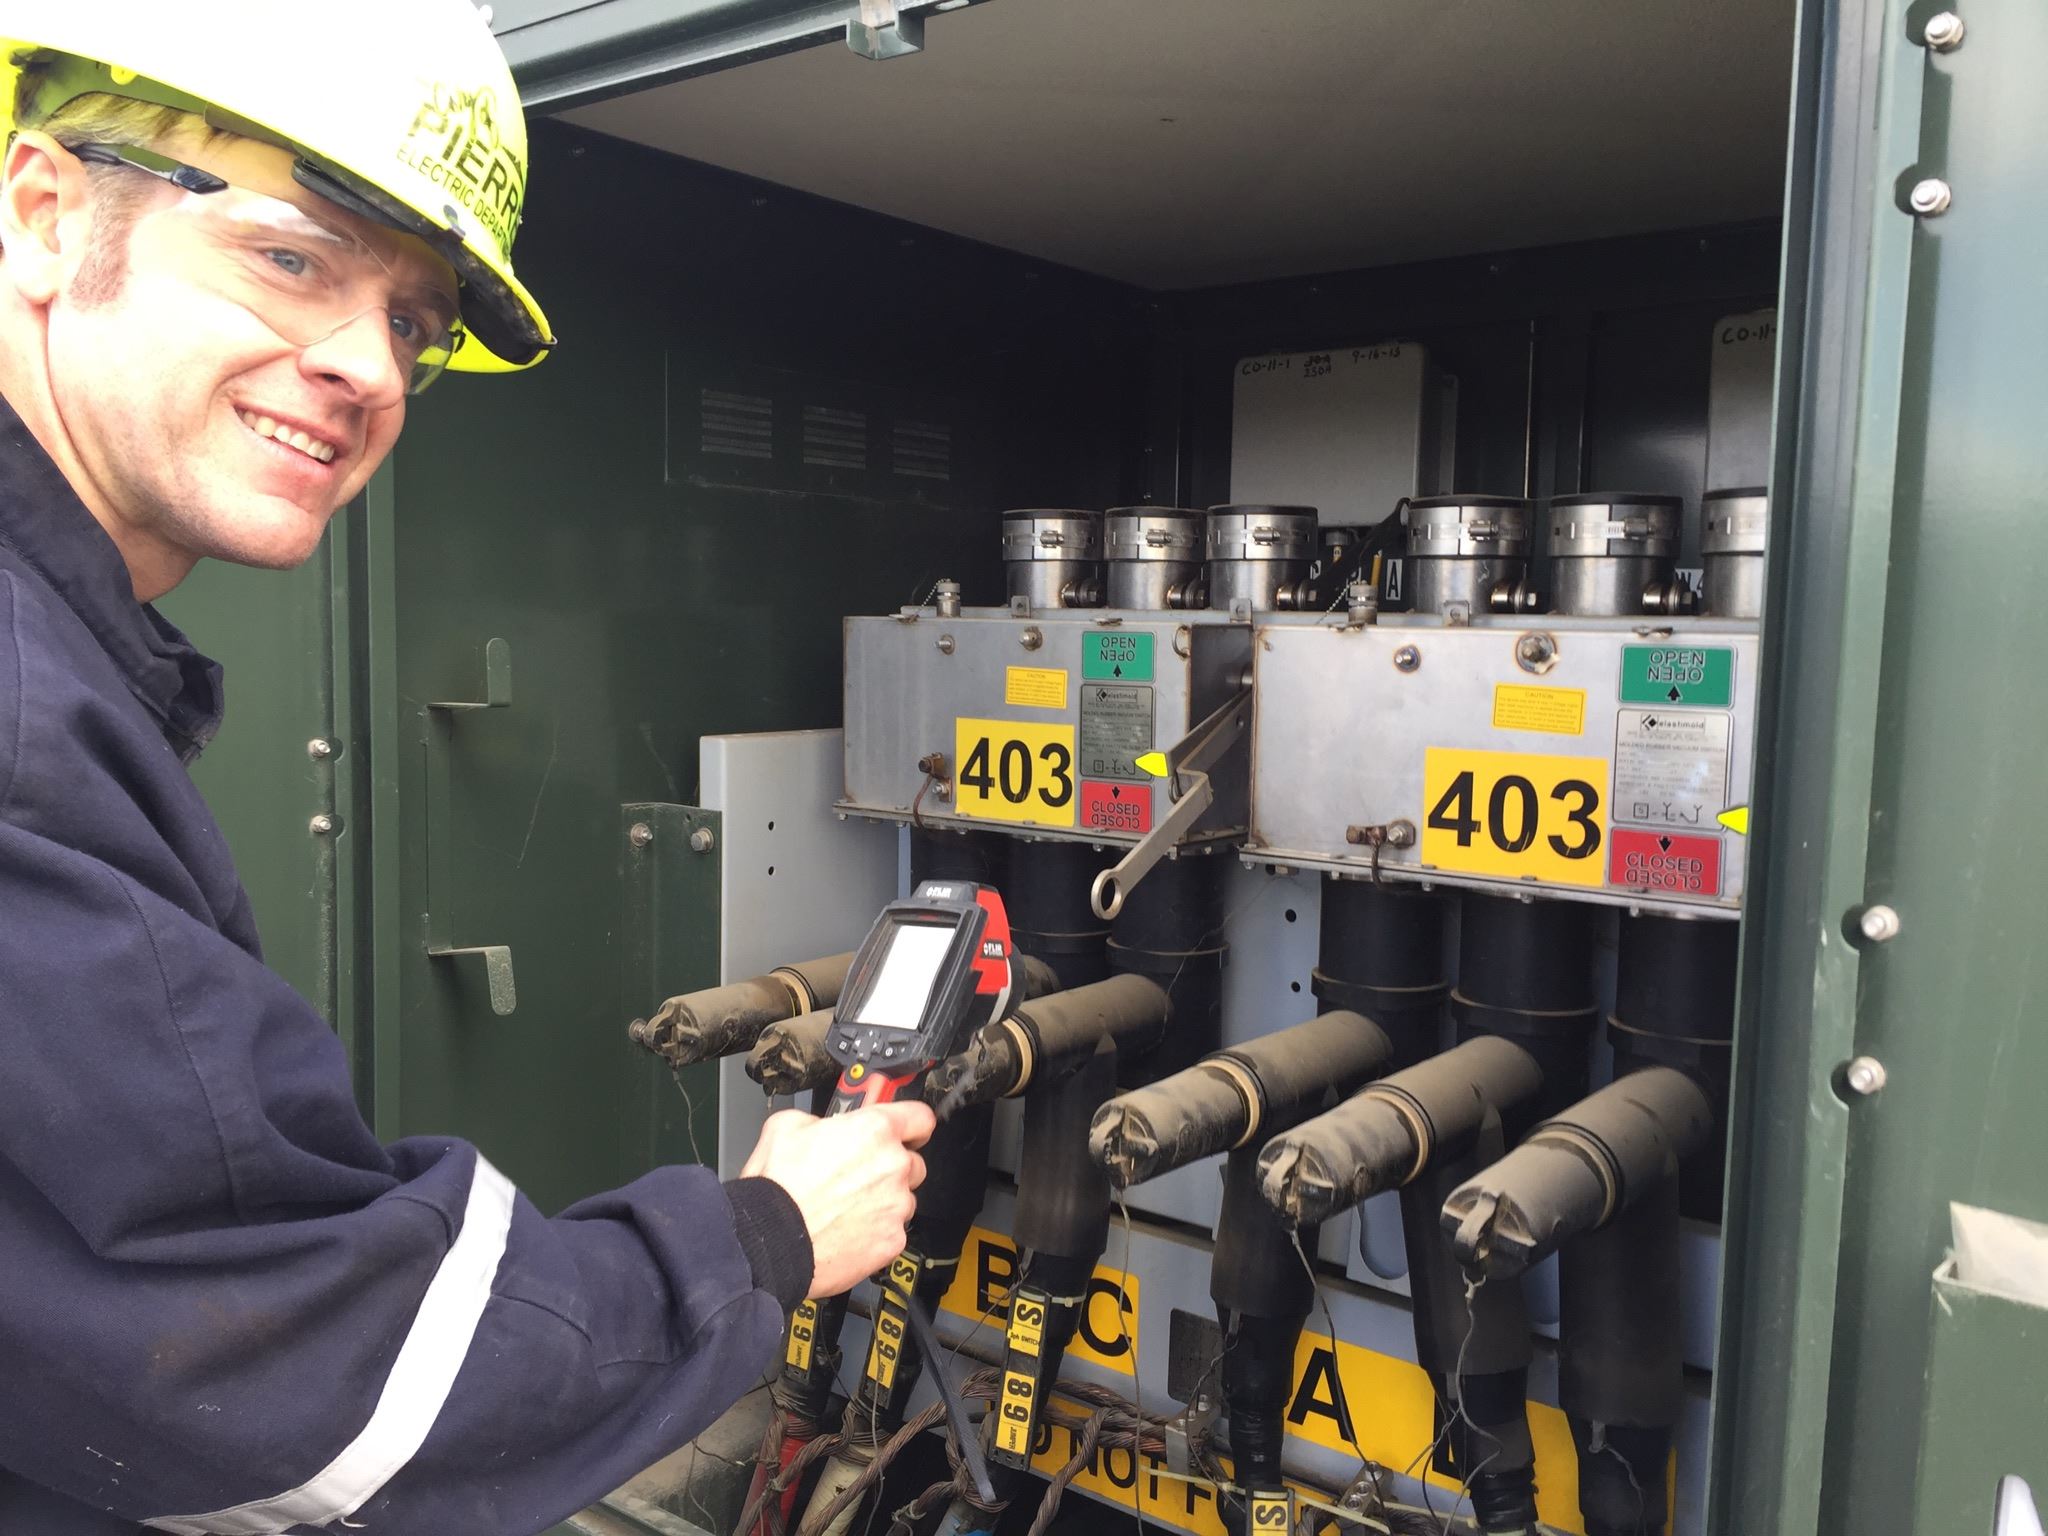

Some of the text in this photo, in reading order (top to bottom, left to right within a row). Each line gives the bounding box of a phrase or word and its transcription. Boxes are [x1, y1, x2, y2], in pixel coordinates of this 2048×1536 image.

[397, 144, 474, 206] ELECTRIC
[1387, 560, 1399, 598] A
[1101, 637, 1136, 649] OPEN
[1100, 650, 1135, 662] OPEN
[1651, 651, 1704, 665] OPEN
[1648, 667, 1702, 681] OPEN
[960, 737, 1073, 807] 403
[1092, 801, 1140, 816] CLOSED
[1428, 771, 1601, 859] 403
[1092, 814, 1139, 829] CLOSED
[1627, 853, 1702, 873] CLOSED
[1627, 869, 1701, 889] CLOSED
[893, 1260, 914, 1282] S
[976, 1240, 1133, 1357] B C
[1016, 1304, 1042, 1325] S
[1287, 1348, 1357, 1445] A
[1255, 1505, 1286, 1526] S
